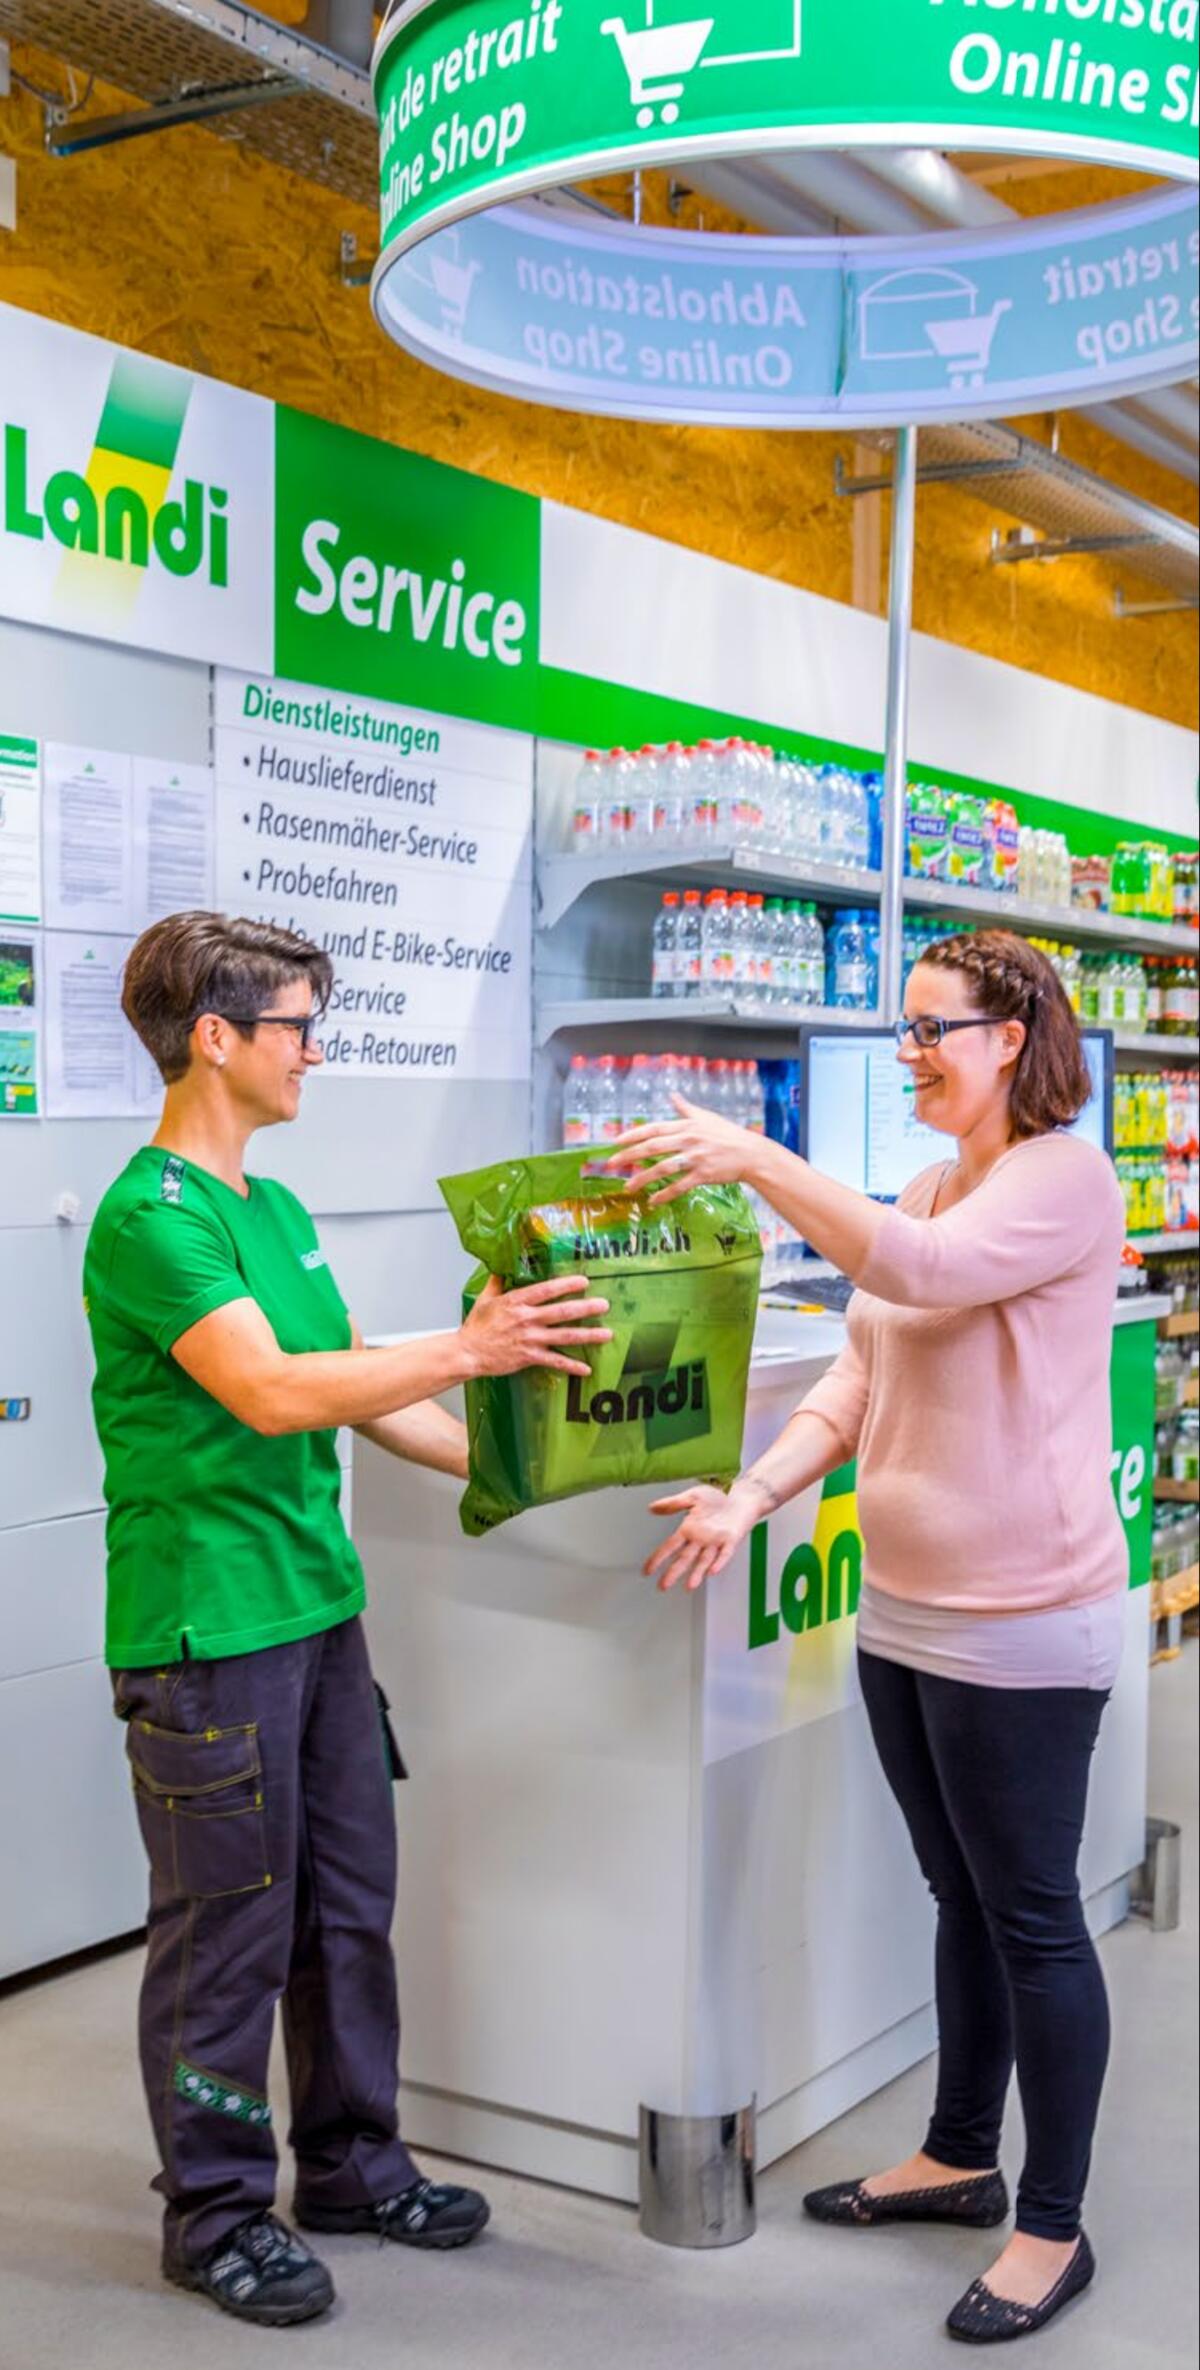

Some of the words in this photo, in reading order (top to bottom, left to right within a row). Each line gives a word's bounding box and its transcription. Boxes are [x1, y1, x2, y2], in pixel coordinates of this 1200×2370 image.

[398, 66, 425, 131] de
[430, 0, 563, 104] retrait
[949, 32, 1150, 113] Online
[429, 102, 526, 183] Shop
[5, 423, 228, 588] Landi
[295, 518, 526, 666] Service
[243, 684, 441, 756] Dienstleistungen
[257, 745, 438, 806] Hauslieferdienst
[257, 802, 478, 865] Rasenmäher-Service
[257, 858, 398, 907] Probefahren
[323, 926, 367, 960] und
[371, 932, 512, 974] E-Bike-Service
[566, 1361, 703, 1424] Landi
